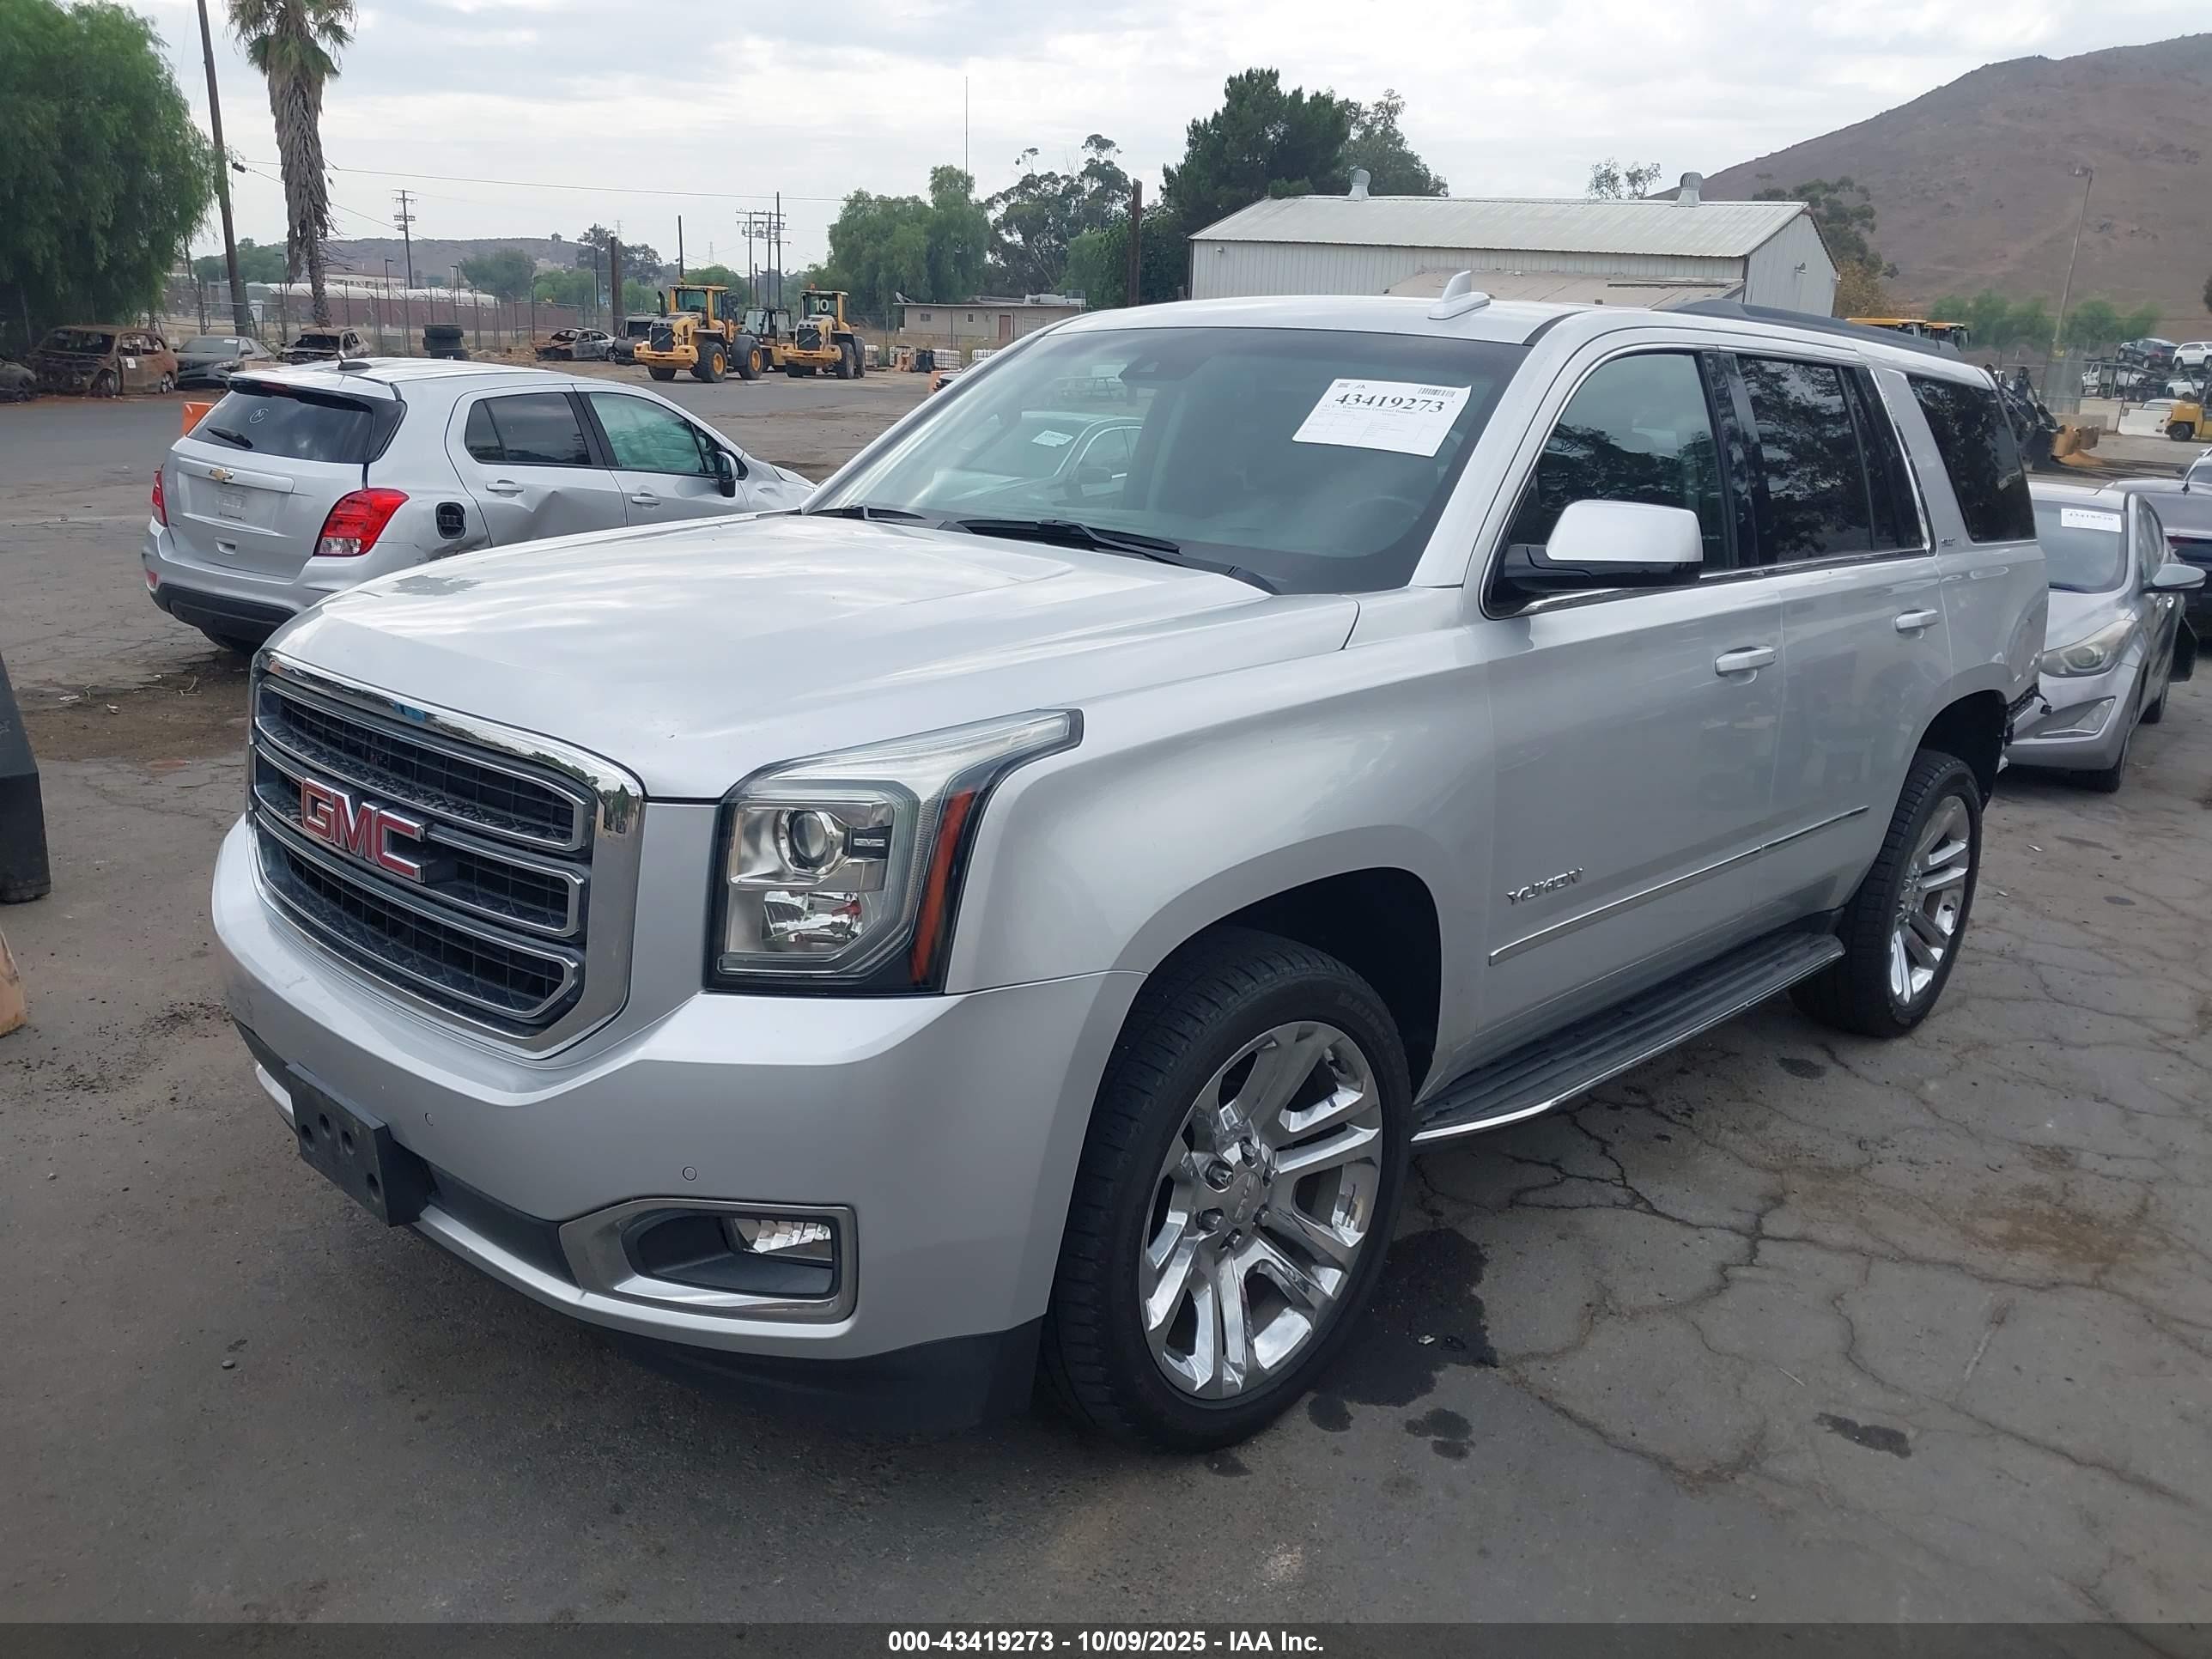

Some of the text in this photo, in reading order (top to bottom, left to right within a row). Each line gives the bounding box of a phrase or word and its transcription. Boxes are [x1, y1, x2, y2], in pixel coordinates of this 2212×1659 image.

[813, 298, 830, 313] 10
[1334, 392, 1445, 413] 43419273
[301, 777, 425, 883] GMC
[1505, 866, 1583, 905] YUKON
